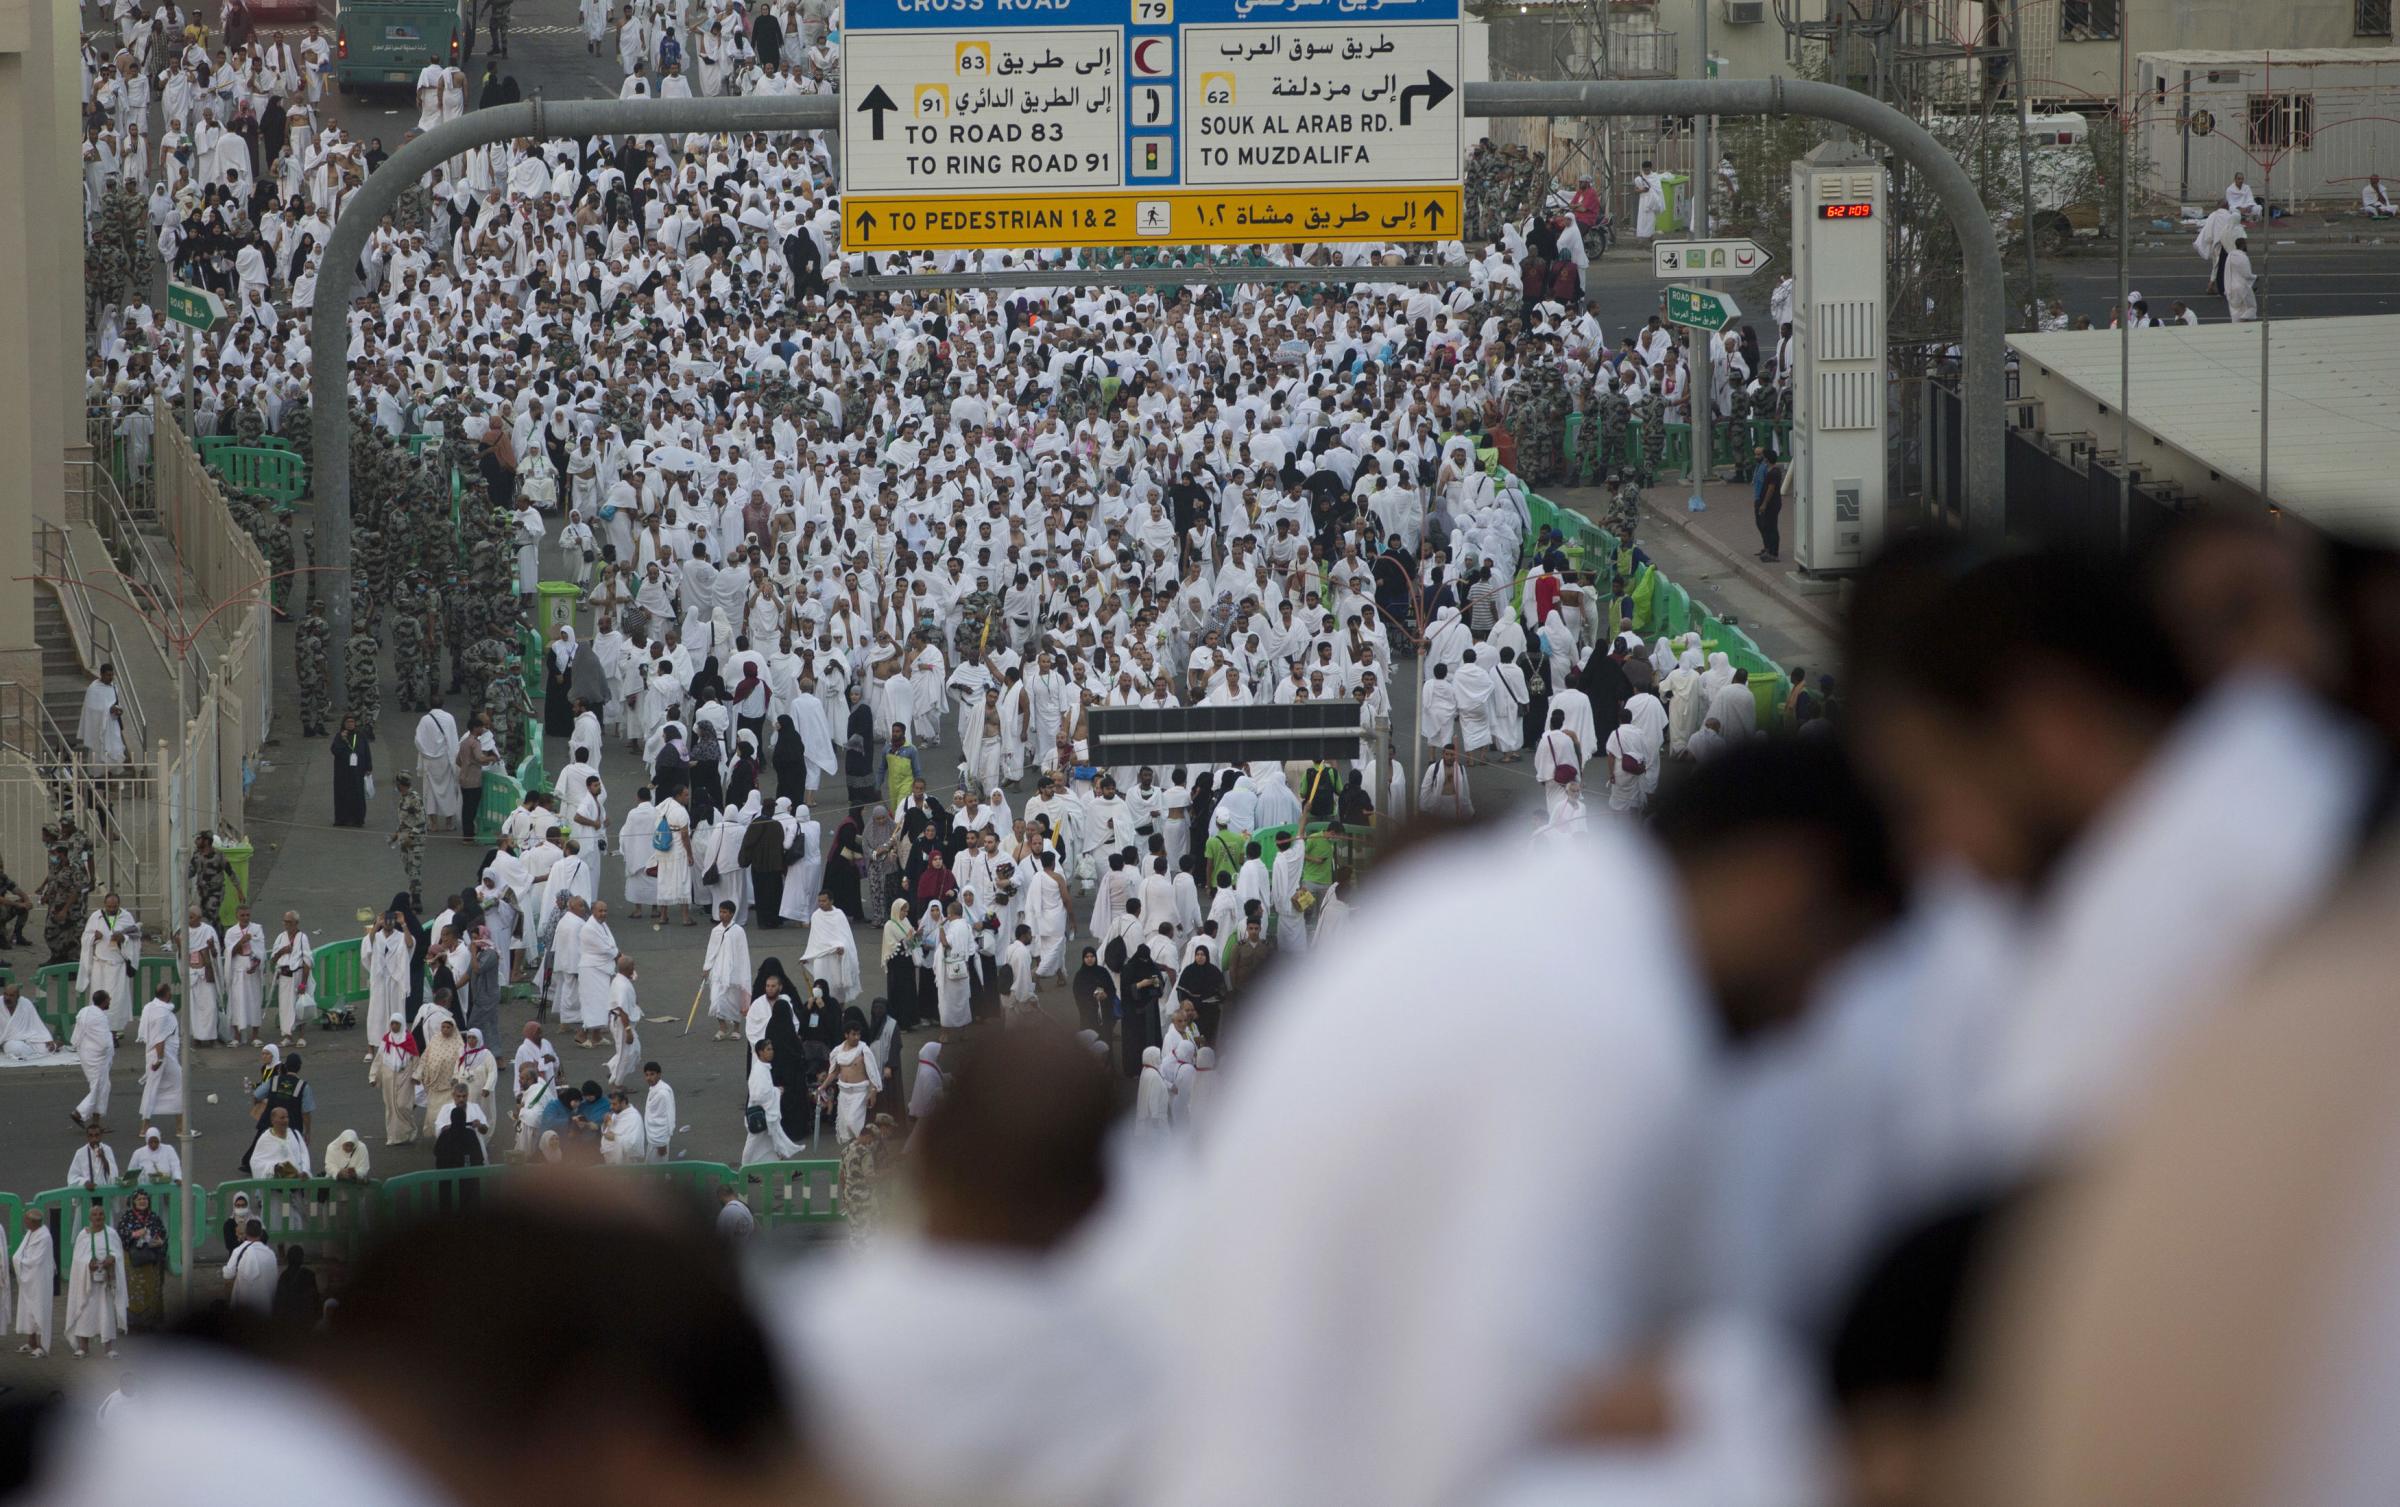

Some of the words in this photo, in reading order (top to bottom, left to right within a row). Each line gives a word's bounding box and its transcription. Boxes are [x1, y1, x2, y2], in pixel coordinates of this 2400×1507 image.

[897, 0, 984, 12] CROSS
[997, 0, 1071, 10] ROAD
[1138, 2, 1167, 19] 79
[1220, 34, 1281, 62] العرب
[1288, 38, 1334, 62] سوق
[1341, 33, 1395, 61] طريق
[961, 55, 985, 70] 83
[996, 48, 1065, 76] طريق
[1075, 47, 1111, 76] إلى
[1086, 85, 1111, 114] إلى
[1207, 90, 1229, 104] 62
[1271, 75, 1351, 102] مزدلفة
[1361, 73, 1397, 103] إلى
[922, 98, 940, 112] 91
[955, 87, 1014, 116] الدائري
[1020, 86, 1080, 114] الطريق
[904, 125, 938, 145] TO
[950, 123, 1022, 144] ROAD
[1031, 122, 1064, 142] 83
[1200, 115, 1255, 136] SOUK
[1262, 115, 1290, 134] AL
[1295, 114, 1353, 134] ARAB
[1361, 113, 1393, 133] RD.
[906, 155, 937, 175] TO
[946, 154, 1002, 175] RING
[1011, 153, 1078, 173] ROAD
[1085, 153, 1109, 172] 91
[1200, 147, 1229, 166] TO
[1238, 144, 1370, 166] MUZDALIFA
[888, 212, 916, 231] TO
[925, 209, 1063, 231] PEDESTRIAN
[1072, 209, 1079, 228] 1
[1084, 208, 1097, 228] &
[1103, 208, 1116, 227] 2
[1236, 204, 1294, 225] مشاة
[1304, 202, 1370, 230] طريق
[1381, 200, 1417, 230] إلى
[1672, 291, 1690, 303] ROAD
